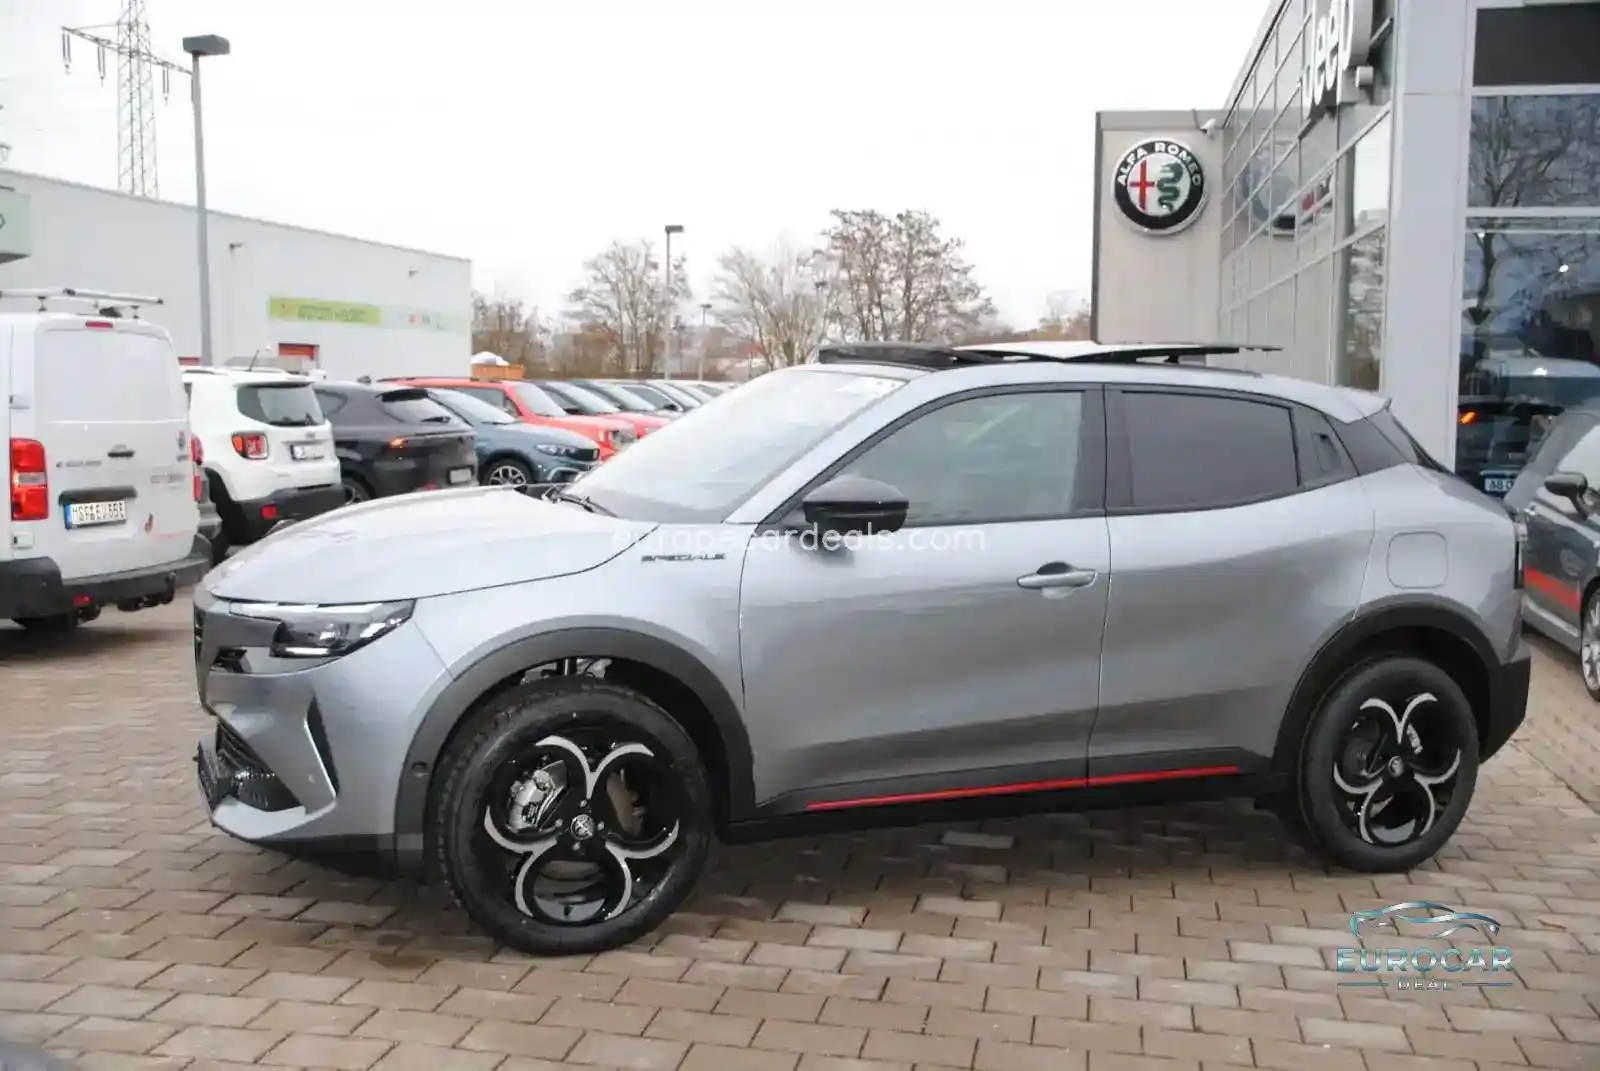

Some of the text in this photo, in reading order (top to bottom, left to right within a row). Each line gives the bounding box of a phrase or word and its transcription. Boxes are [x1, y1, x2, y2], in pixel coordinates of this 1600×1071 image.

[1117, 142, 1202, 187] ALFA ROMEO
[641, 553, 726, 562] SPECIALE
